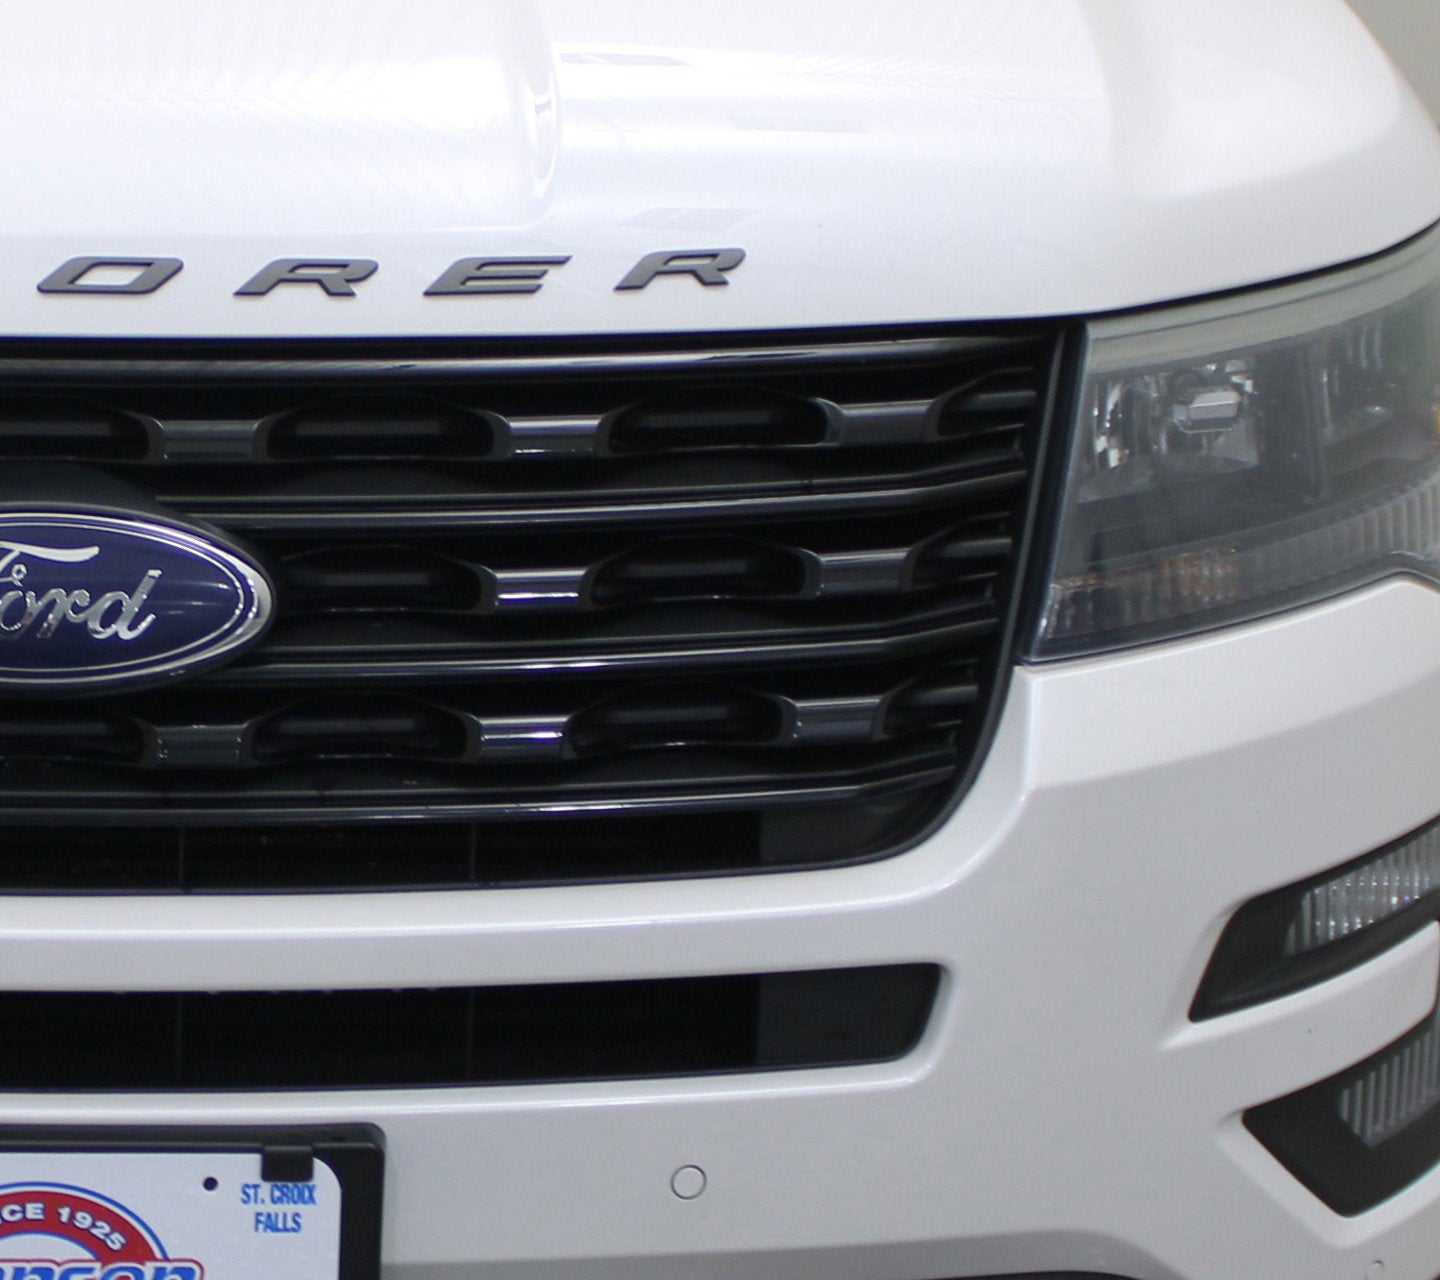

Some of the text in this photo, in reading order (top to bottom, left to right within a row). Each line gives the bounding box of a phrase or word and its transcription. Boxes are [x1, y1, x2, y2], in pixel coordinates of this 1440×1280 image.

[241, 1183, 317, 1205] ST. CROIX
[57, 1206, 126, 1252] 1925
[254, 1212, 302, 1233] FALLS
